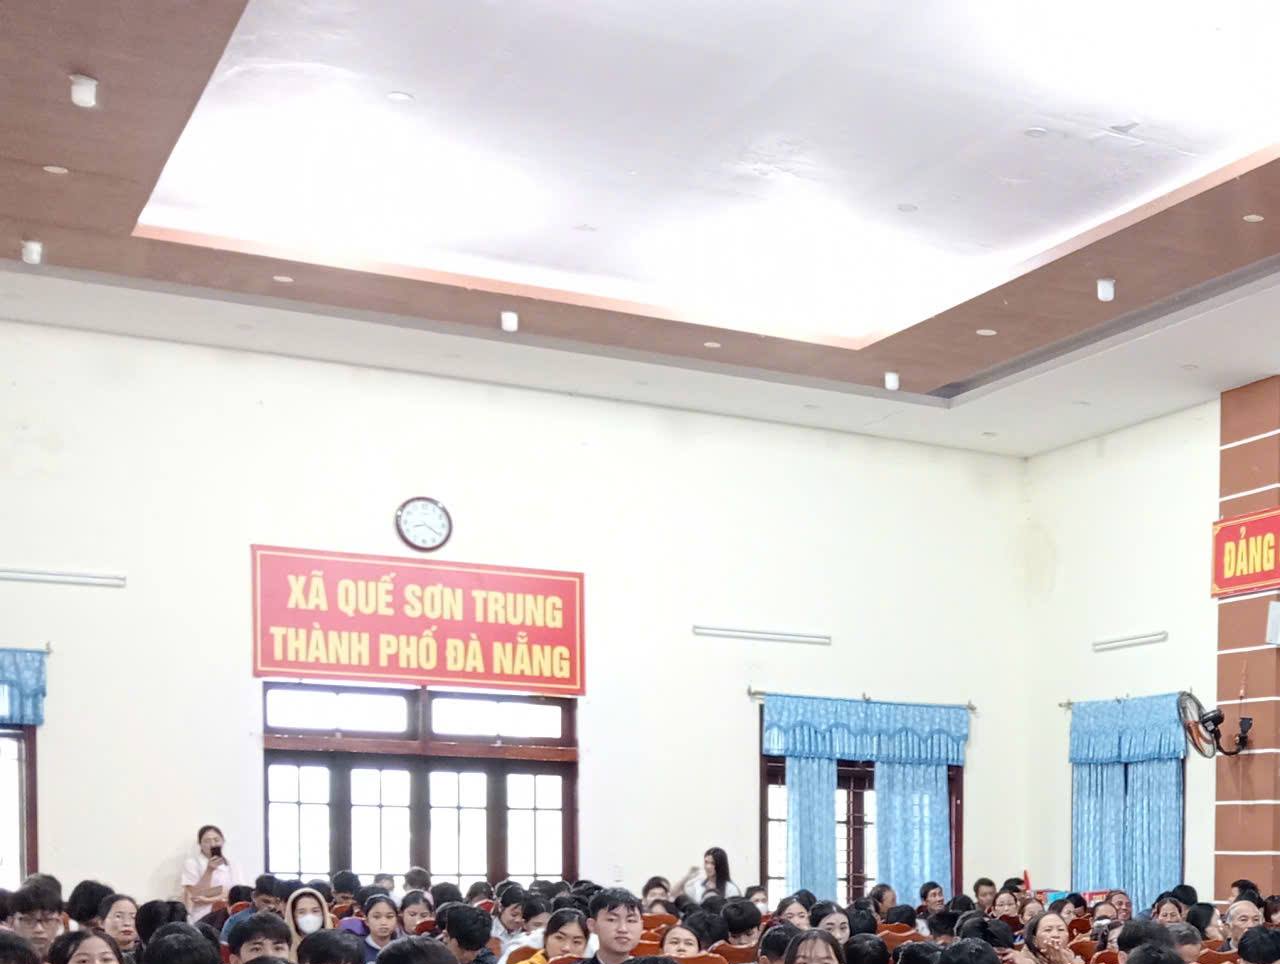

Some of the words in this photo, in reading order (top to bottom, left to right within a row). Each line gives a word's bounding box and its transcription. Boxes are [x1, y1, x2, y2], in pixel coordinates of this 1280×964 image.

[1224, 526, 1275, 578] ĐẢNG
[286, 570, 329, 611] XÃ
[337, 571, 397, 617] QUẾ
[404, 582, 464, 622] SƠN
[471, 589, 564, 629] TRUNG
[269, 622, 371, 668] THÀNH
[379, 624, 438, 671] PHỐ
[446, 632, 486, 674] ĐÀ
[493, 631, 571, 679] NẴNG
